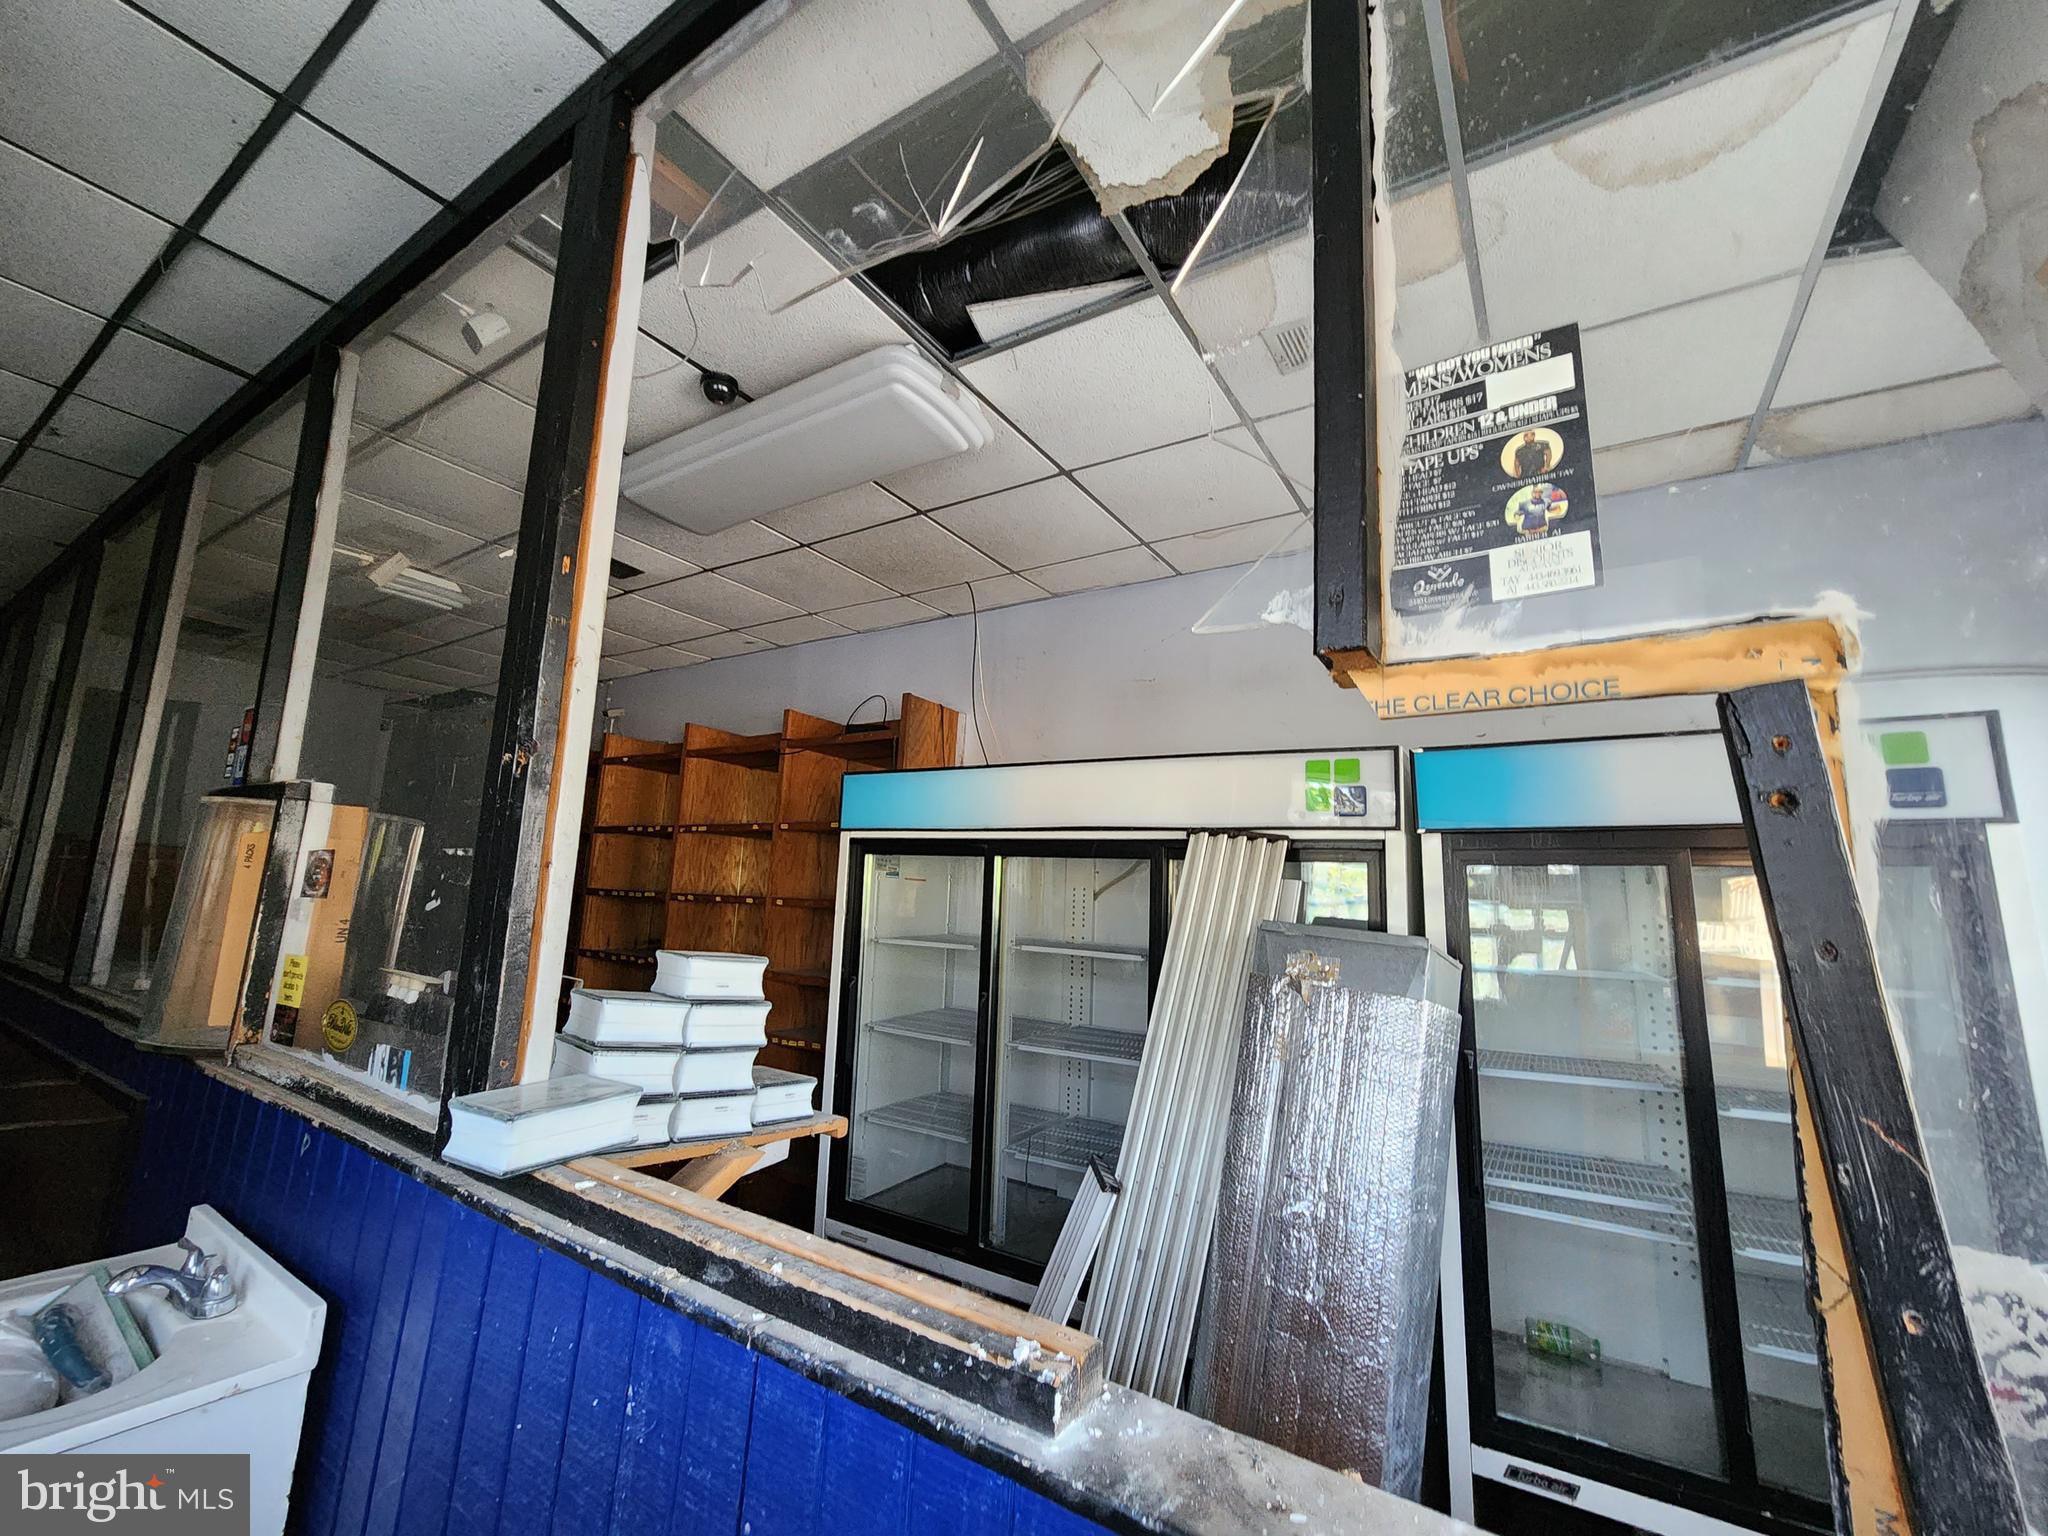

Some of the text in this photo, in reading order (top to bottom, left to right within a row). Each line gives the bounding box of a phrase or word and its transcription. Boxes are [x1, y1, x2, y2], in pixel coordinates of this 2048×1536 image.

[1437, 355, 1462, 374] GOT
[1462, 346, 1490, 368] YOU
[1478, 412, 1495, 429] 12
[1508, 395, 1558, 422] UNDER
[1413, 688, 1501, 713] CLEAR
[1508, 676, 1622, 705] CHOICE
